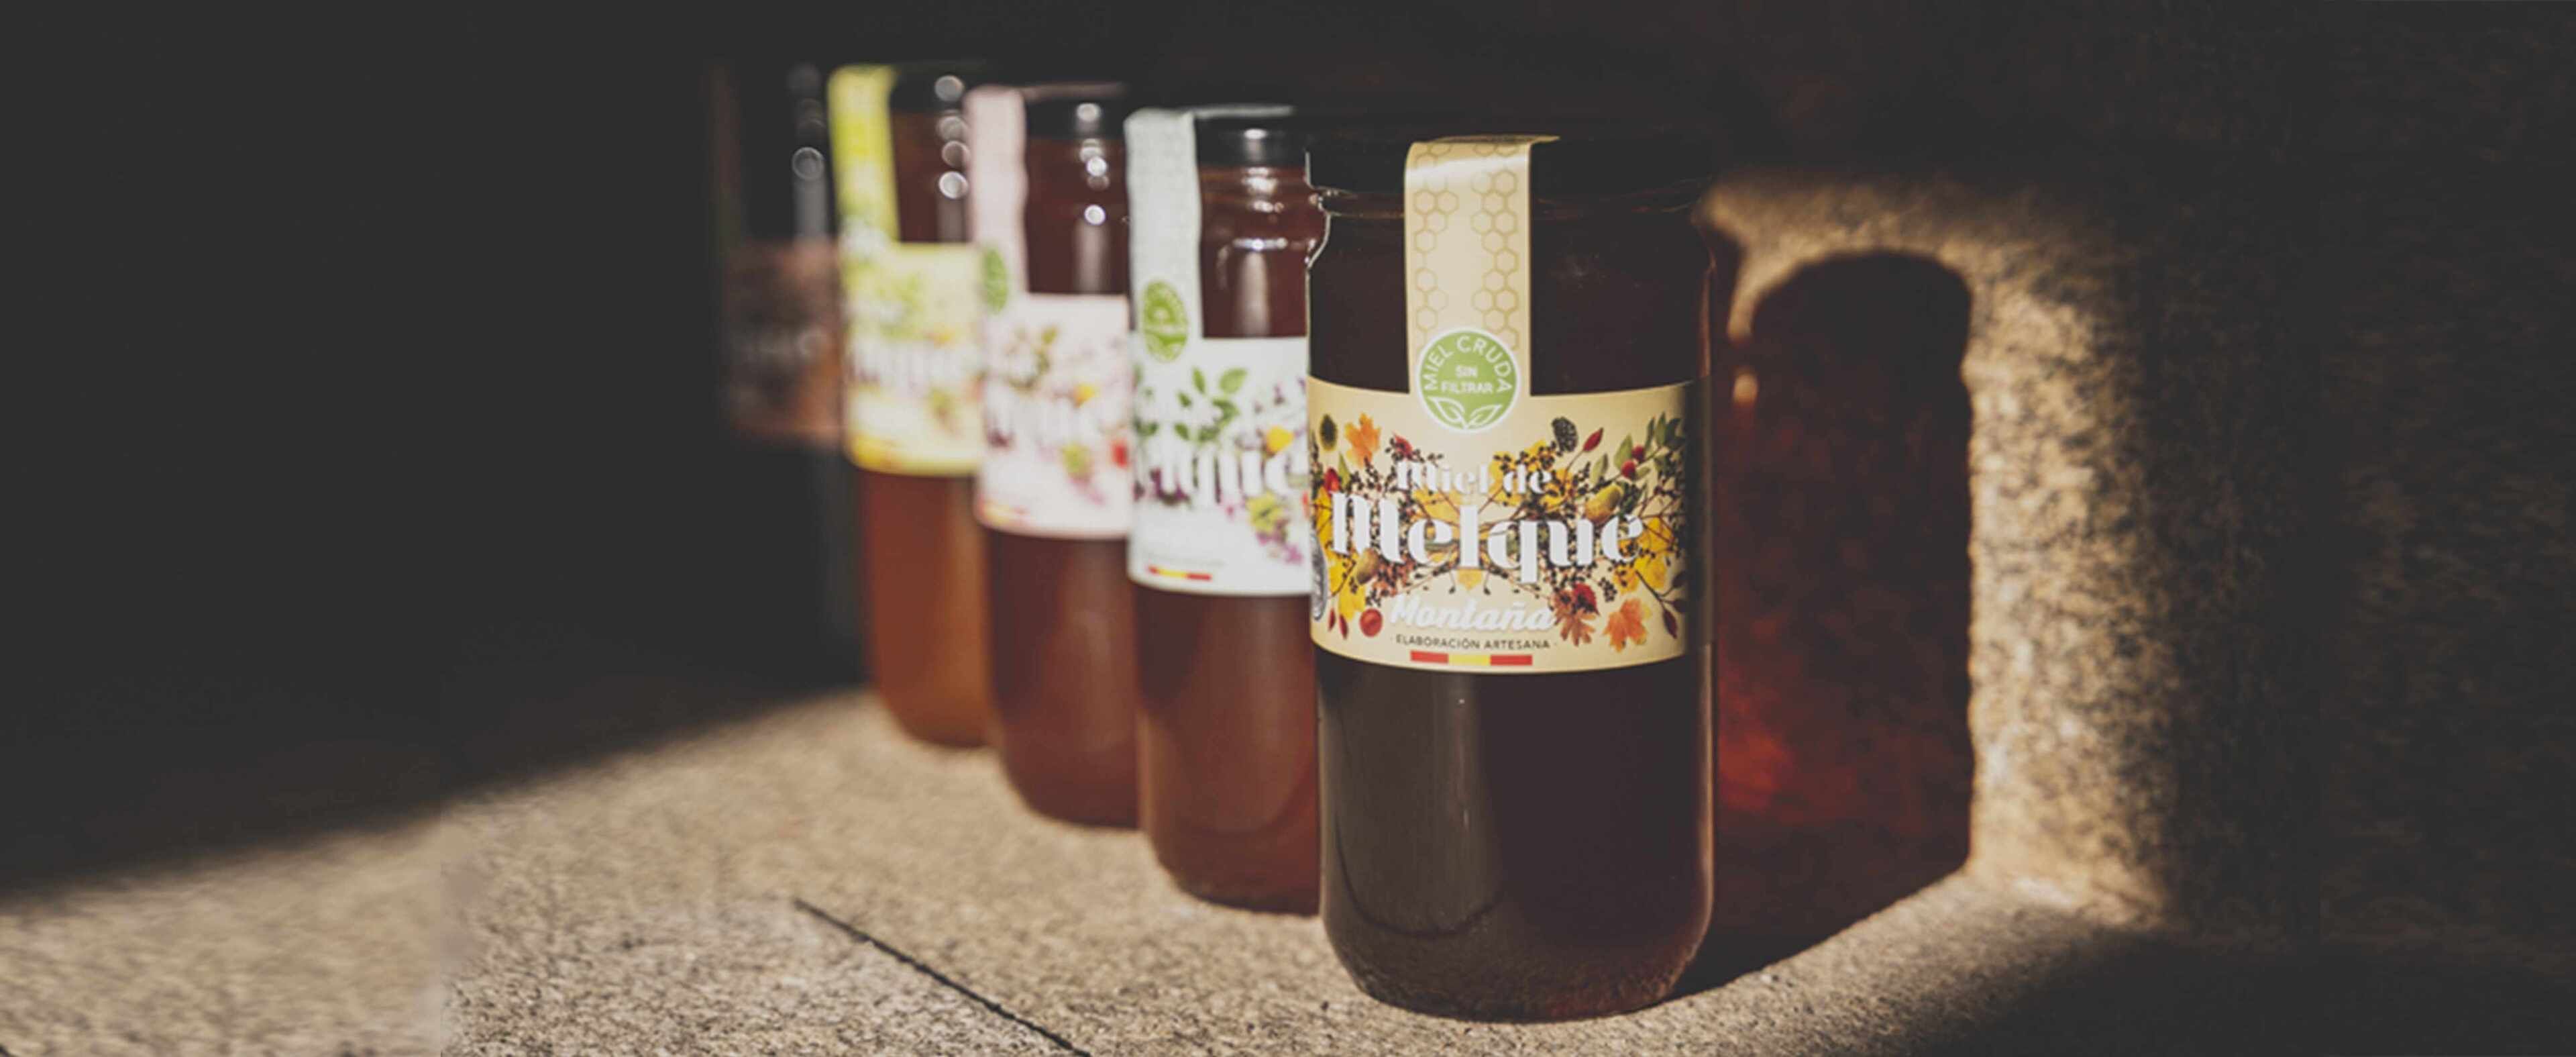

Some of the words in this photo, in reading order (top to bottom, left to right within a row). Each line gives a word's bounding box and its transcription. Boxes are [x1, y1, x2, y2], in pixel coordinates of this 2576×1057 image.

[1423, 345, 1454, 391] MIEL
[1456, 336, 1513, 393] CRUDA
[1455, 365, 1478, 378] SIN
[1441, 381, 1493, 393] FILTRAR
[1397, 461, 1490, 495] Miel
[1503, 464, 1552, 494] de
[1331, 493, 1643, 585] Melque
[1389, 594, 1555, 632] Montaña
[1396, 634, 1480, 649] ELABORACIÓN
[1484, 640, 1550, 650] ARTESANA
